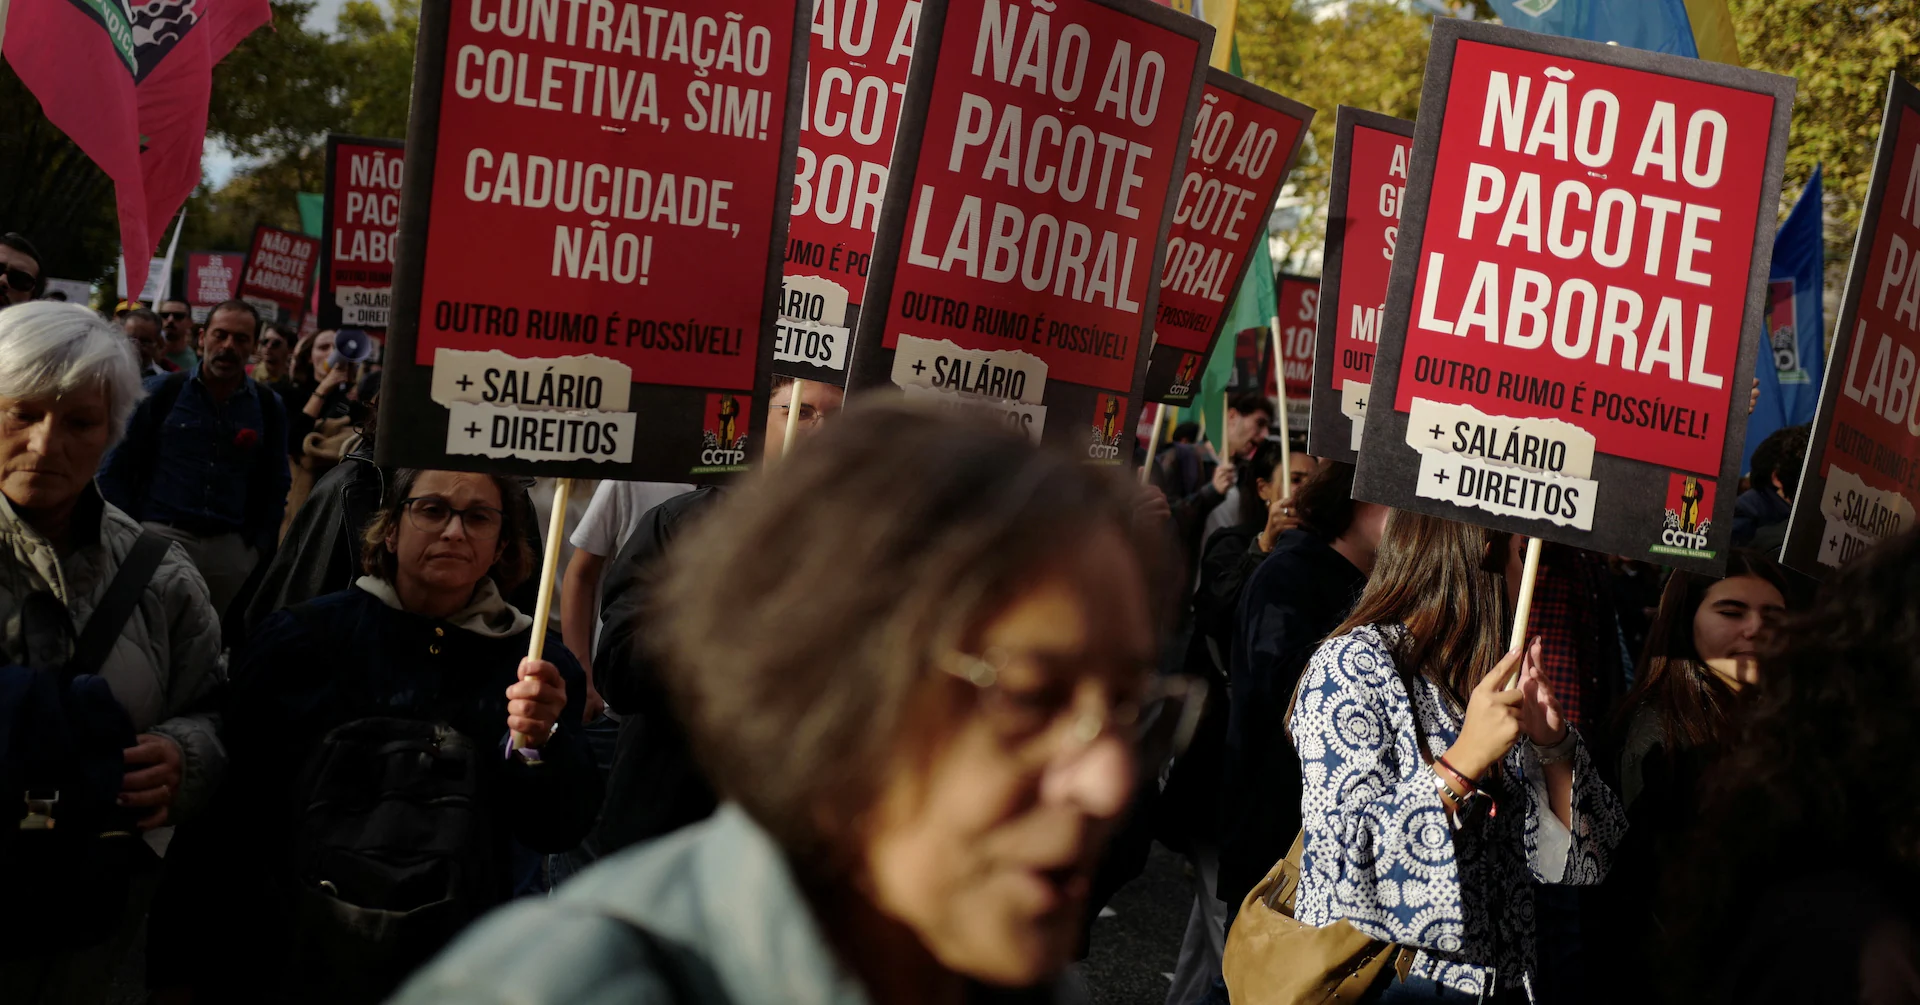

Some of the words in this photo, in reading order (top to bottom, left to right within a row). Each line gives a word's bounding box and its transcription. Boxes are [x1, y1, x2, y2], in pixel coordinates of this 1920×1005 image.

[471, 0, 771, 78] CONTRATAÇÃO
[972, 0, 1091, 103] NÃO
[1094, 39, 1166, 127] AO
[455, 45, 669, 133] COLETIVA,
[684, 80, 771, 141] SIM!
[801, 61, 906, 145] CO
[1226, 121, 1278, 180] AO
[1478, 65, 1620, 167] NÃO
[1632, 100, 1728, 188] AO
[350, 151, 405, 190] NÃO
[949, 91, 1153, 220] PACOTE
[1389, 144, 1412, 179] A
[346, 191, 400, 226] PAC
[464, 148, 740, 238] CADUCIDADE,
[1172, 171, 1256, 241] COTE
[260, 231, 291, 255] NÃO
[291, 240, 312, 260] AO
[907, 184, 1140, 314] LABORAL
[1457, 161, 1721, 287] PACOTE
[255, 250, 308, 279] PACOTE
[551, 220, 653, 285] NÃO!
[829, 243, 842, 272] É
[245, 267, 305, 297] LABORAL
[435, 301, 519, 337] OUTRO
[526, 308, 598, 345] RUMO
[605, 312, 620, 346] É
[626, 318, 743, 356] POSSÍVEL!
[901, 290, 969, 329] OUTRO
[972, 304, 1029, 341] RUMO
[1031, 312, 1046, 343] É
[1047, 321, 1128, 362] POSSÍVEL!
[1161, 306, 1213, 332] POSSÍVEL!
[1417, 252, 1724, 390] LABORAL
[481, 366, 603, 409] SALÁRIO
[931, 355, 1026, 401] SALÁRIO
[1343, 350, 1375, 373] OUT
[1170, 384, 1190, 395] CGTP
[1414, 355, 1491, 394] OUTRO
[1499, 371, 1565, 410] RUMO
[1570, 382, 1587, 415] É
[1592, 393, 1708, 440] POSSÍVEL!
[490, 414, 619, 455] DIREITOS
[701, 448, 745, 465] CGTP
[1088, 443, 1119, 459] CGTP
[1452, 420, 1566, 472] SALÁRIO
[1457, 466, 1579, 519] DIREITOS
[1653, 546, 1687, 555] INTERSINDICAL
[1689, 550, 1711, 558] NACIONAL
[1662, 528, 1707, 550] CGTP
